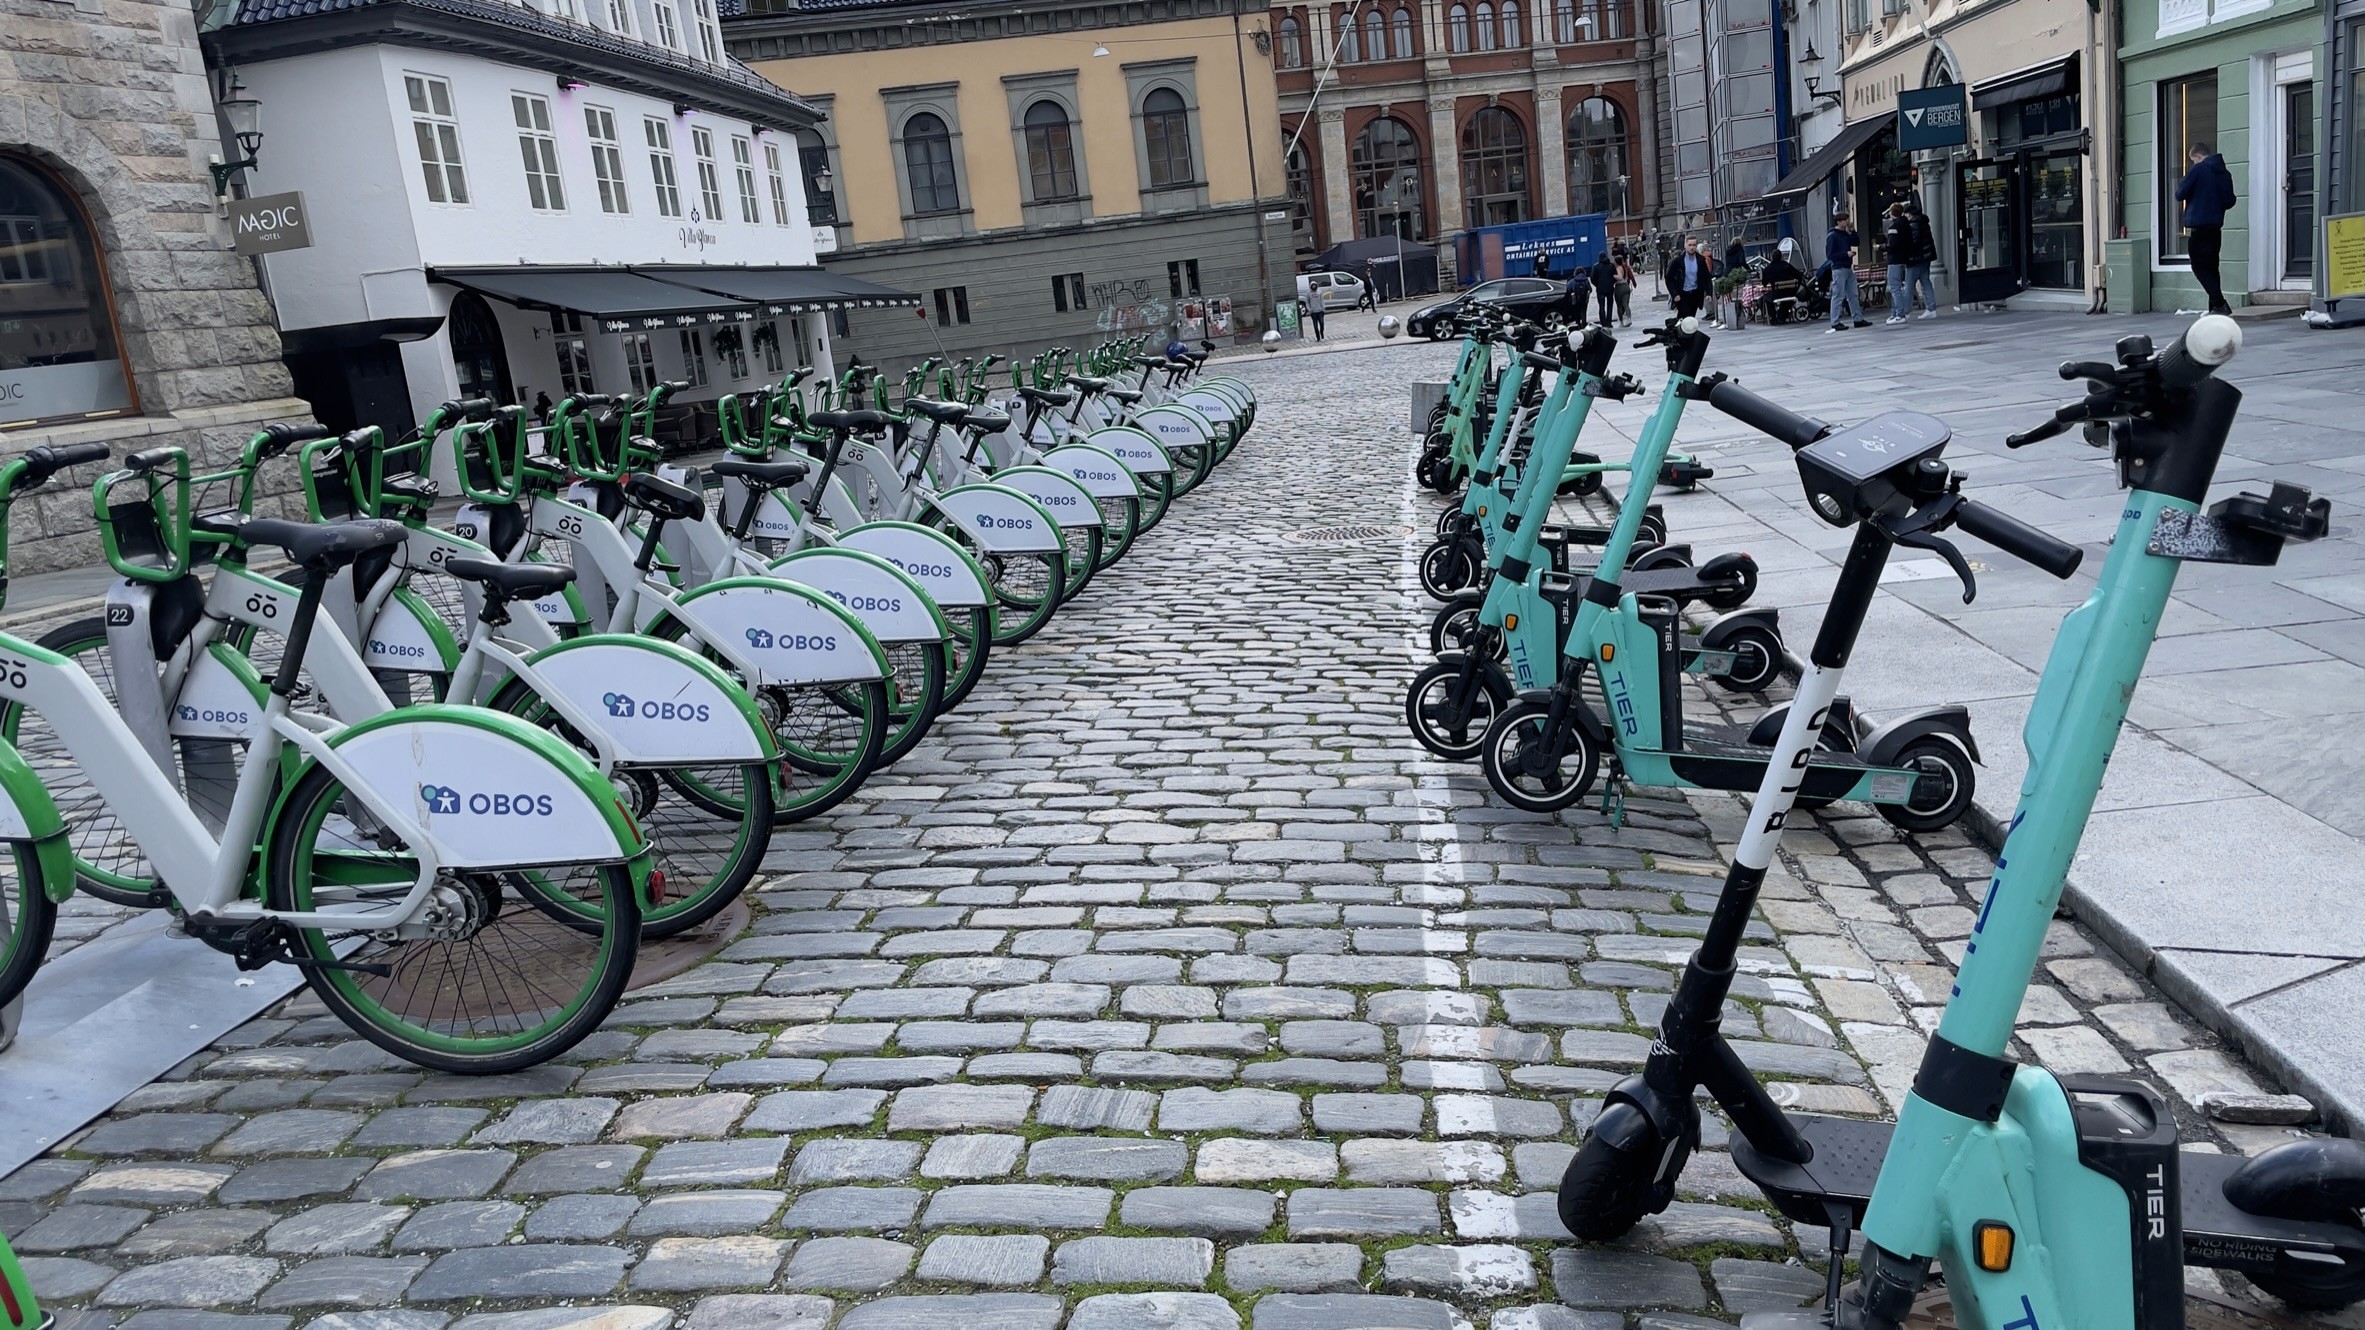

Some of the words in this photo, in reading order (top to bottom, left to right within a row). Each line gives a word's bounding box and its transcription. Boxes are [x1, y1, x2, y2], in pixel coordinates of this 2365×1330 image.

[1927, 109, 1961, 125] BERGEN
[259, 232, 281, 241] HOTEL
[1170, 425, 1191, 433] OBOS
[1128, 450, 1153, 459] OBOS
[1088, 471, 1117, 481] OBOS
[1044, 496, 1077, 506] OBOS
[458, 526, 474, 537] 20
[765, 522, 789, 531] OBOS
[997, 518, 1033, 530] OBOS
[1484, 523, 1496, 550] TIE
[908, 563, 952, 578] OBOS
[533, 603, 558, 614] BOS
[851, 596, 901, 613] OBOS
[111, 608, 128, 623] 22
[779, 634, 837, 652] OBOS
[1664, 622, 1673, 652] TIER
[388, 645, 425, 657] OBOS
[1610, 671, 1638, 737] TIER
[202, 709, 249, 725] OBOS
[642, 701, 710, 723] OBOS
[469, 793, 553, 816] OBOS
[2146, 1163, 2165, 1241] TIER
[2198, 1238, 2222, 1249] NO
[2190, 1246, 2275, 1262] SIDEWALKS
